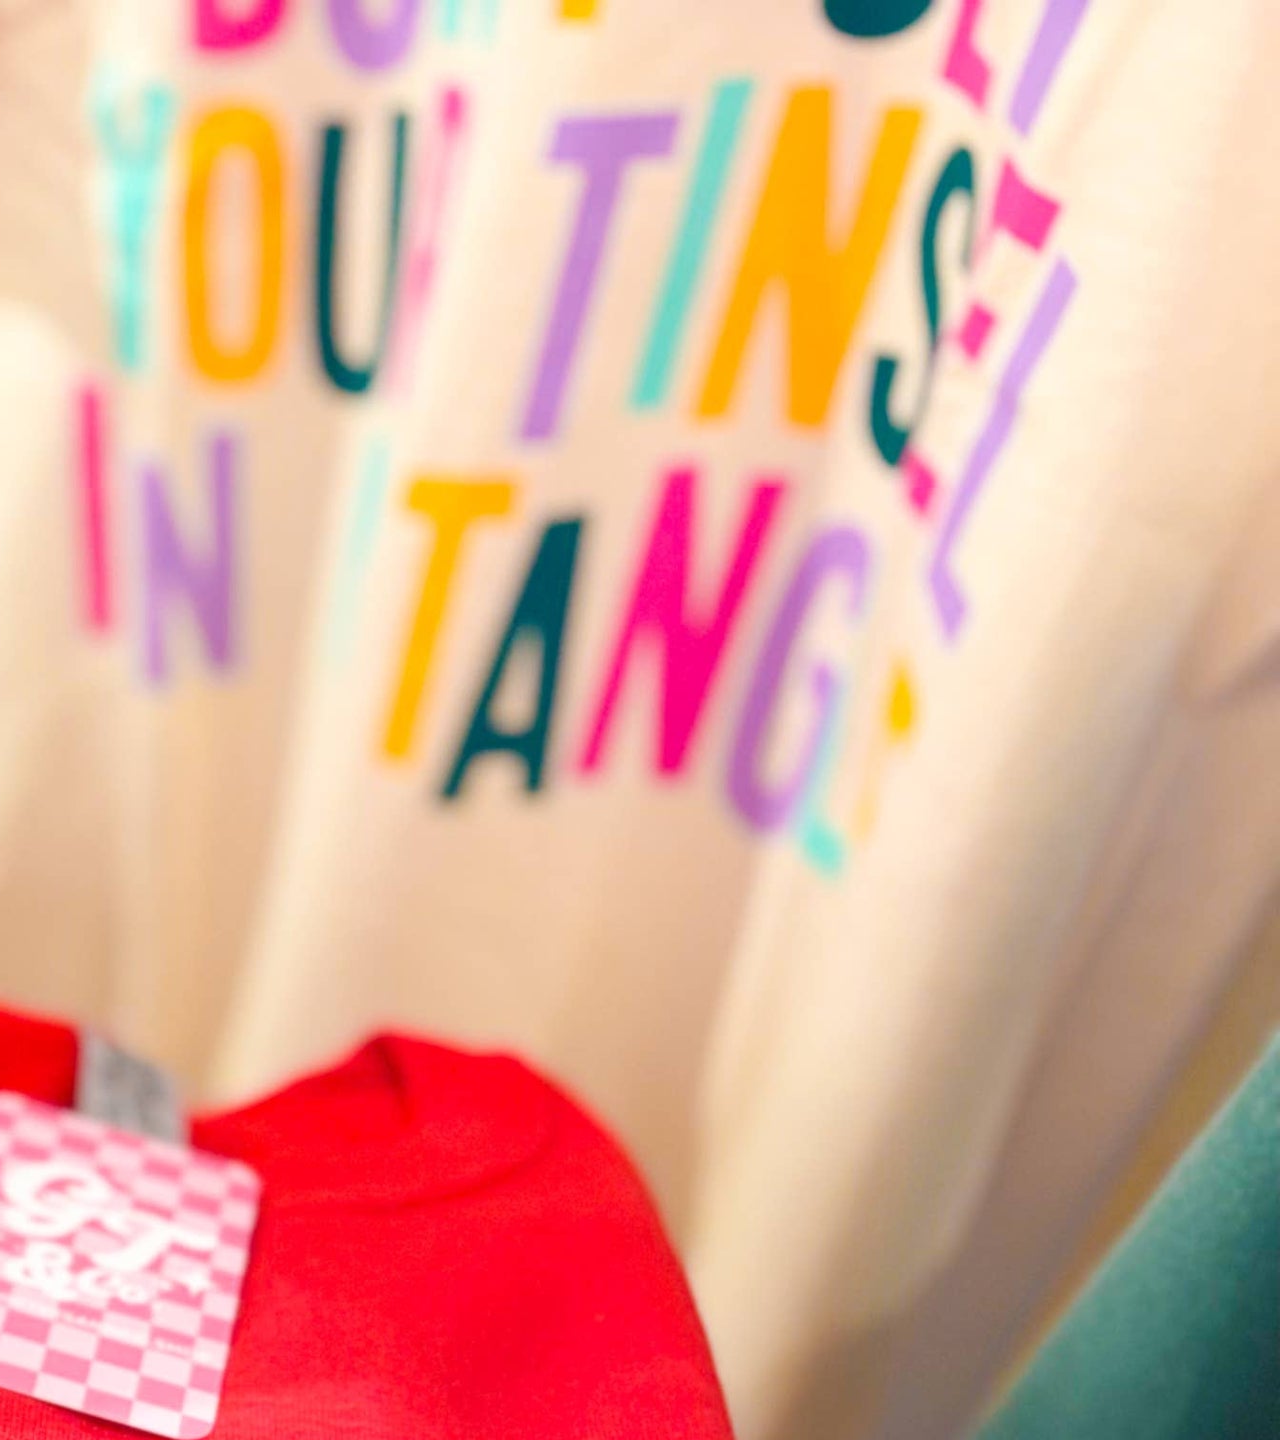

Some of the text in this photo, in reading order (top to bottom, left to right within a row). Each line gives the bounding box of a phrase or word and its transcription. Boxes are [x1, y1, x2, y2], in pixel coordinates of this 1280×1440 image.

[90, 70, 470, 398] YOU
[78, 372, 248, 692] IN
[375, 458, 920, 872] TANG
